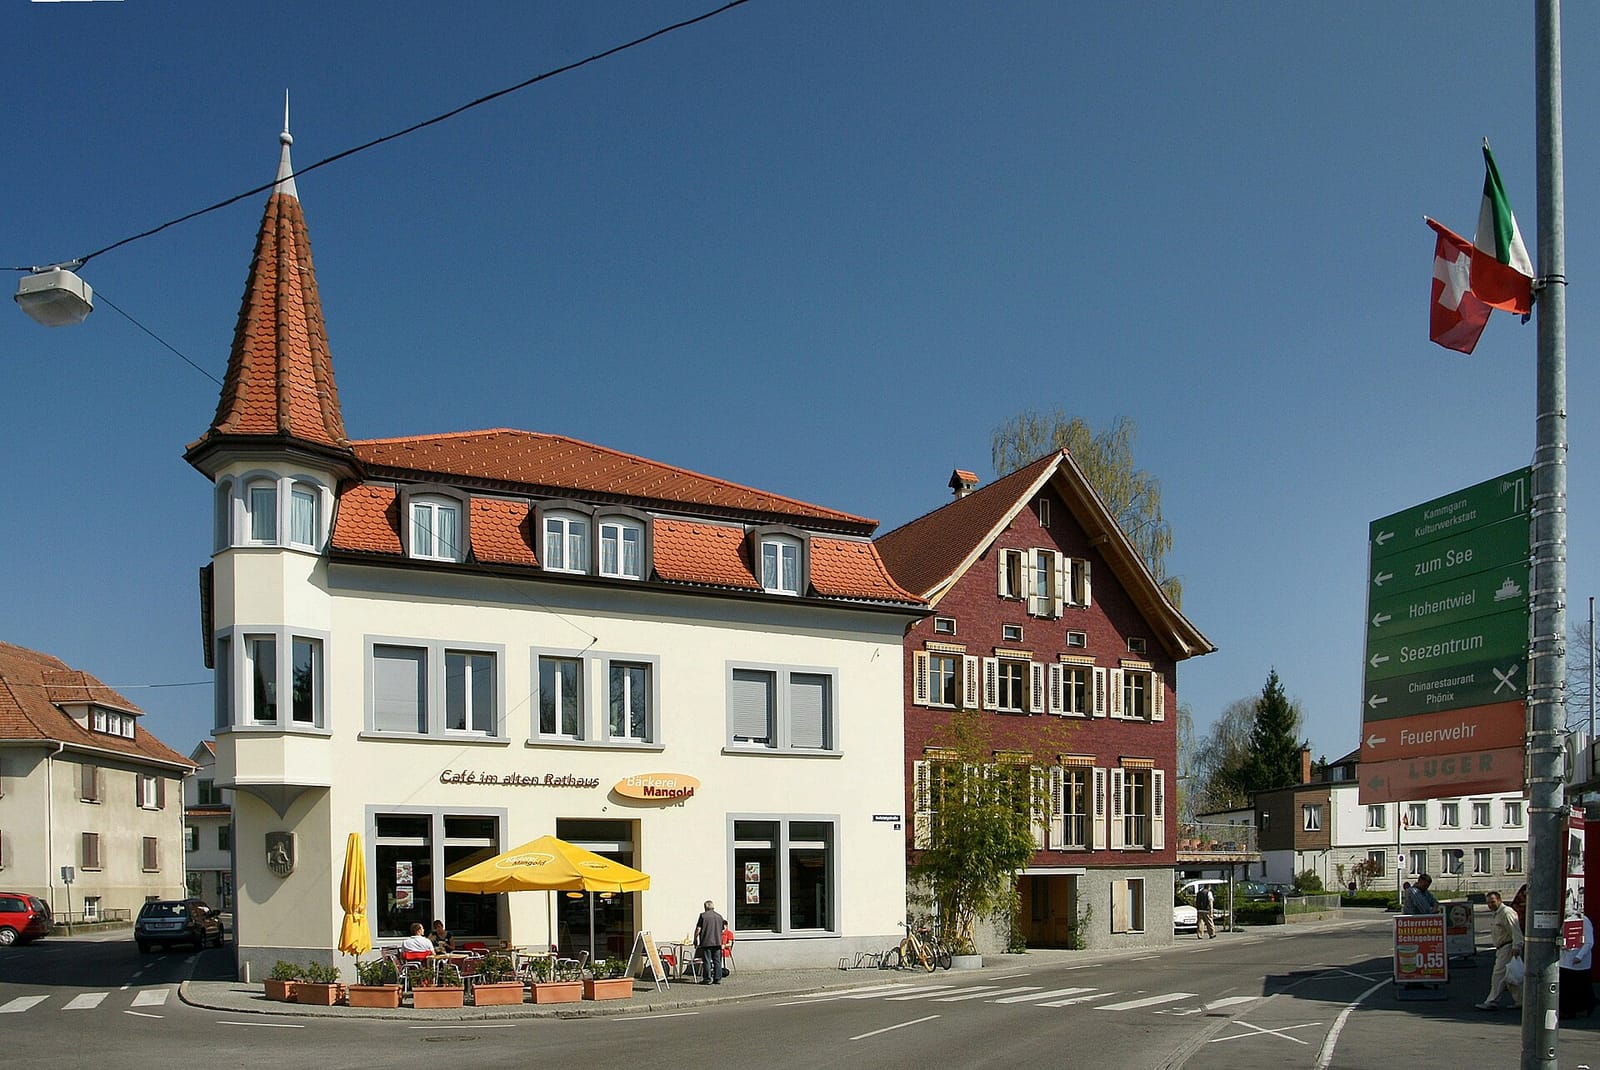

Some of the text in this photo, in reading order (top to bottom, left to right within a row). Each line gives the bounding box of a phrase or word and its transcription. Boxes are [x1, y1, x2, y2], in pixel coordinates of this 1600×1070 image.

[1423, 499, 1468, 521] Kammgarn
[1414, 510, 1477, 537] Kulturwerkstatt
[1414, 549, 1473, 576] zum See
[1409, 589, 1476, 618] Hohentwiel
[1399, 635, 1483, 663] Seezentrum
[1408, 673, 1475, 693] Chinarestaurant
[1400, 722, 1477, 746] Feuerwehr
[1408, 754, 1495, 779] LUGER
[440, 769, 600, 788] Café im alten Rathaus
[626, 776, 678, 788] Bäckerei
[643, 786, 695, 799] Mangold
[1416, 952, 1444, 970] 0,55
